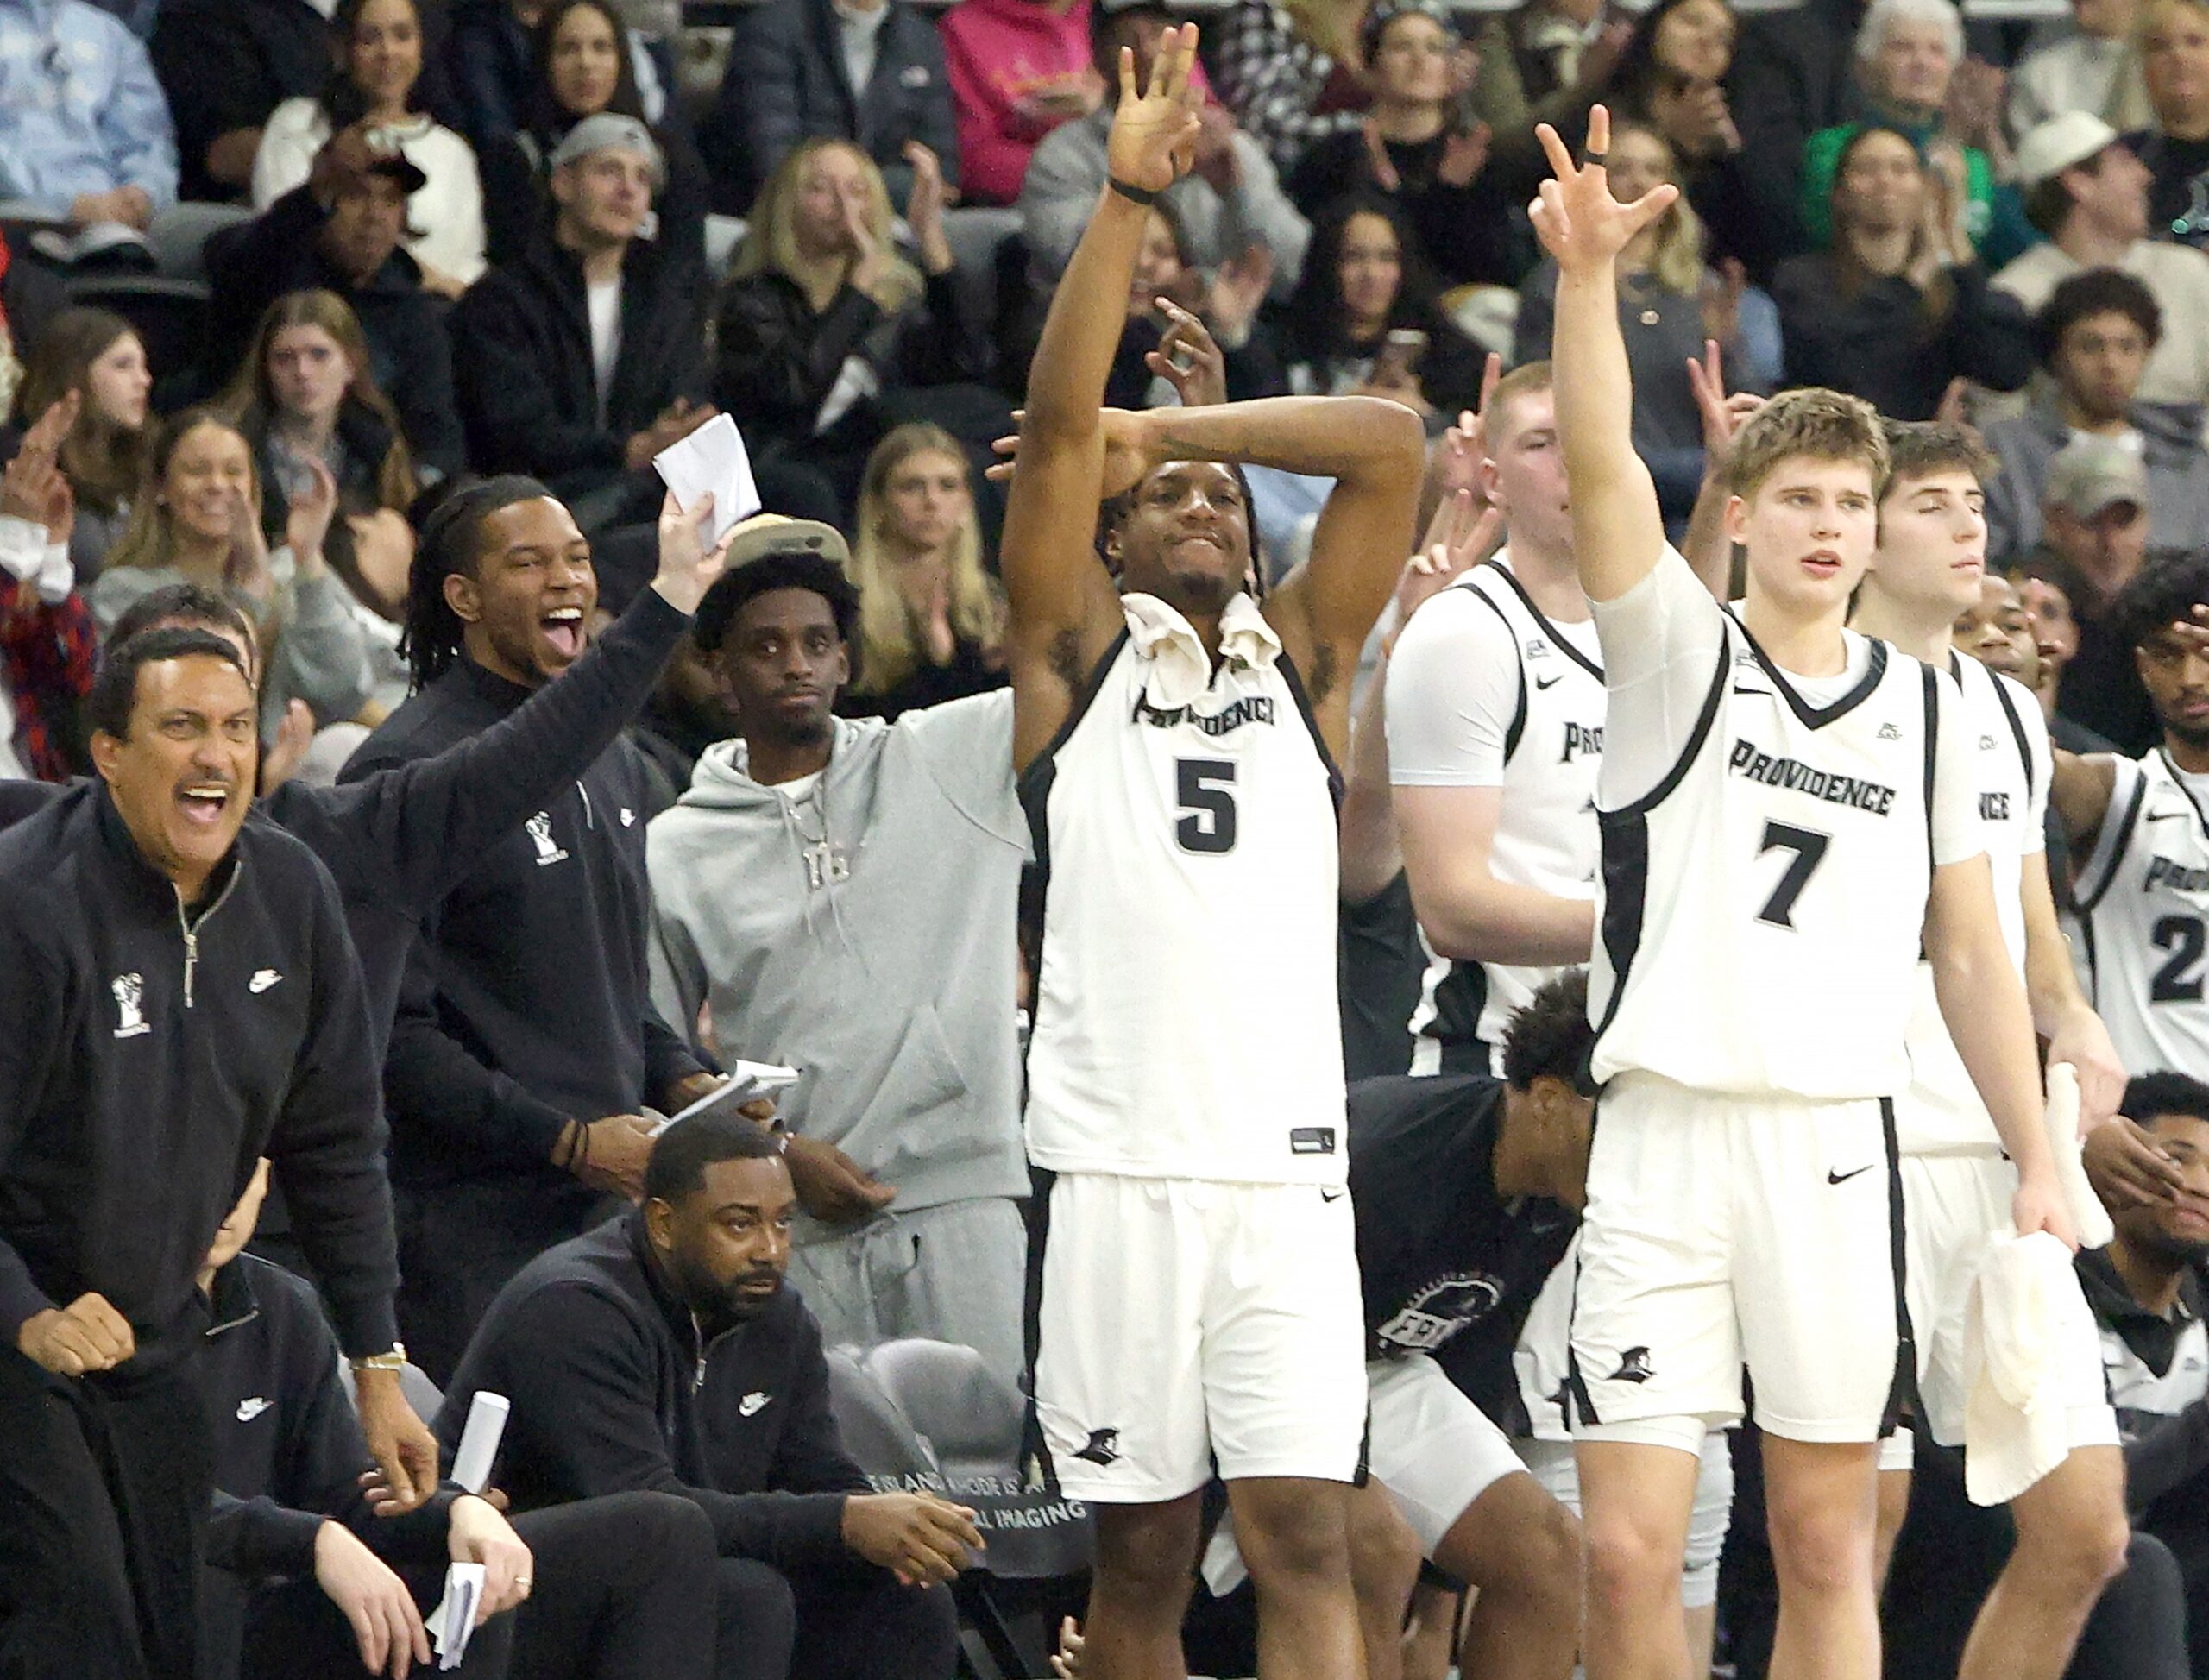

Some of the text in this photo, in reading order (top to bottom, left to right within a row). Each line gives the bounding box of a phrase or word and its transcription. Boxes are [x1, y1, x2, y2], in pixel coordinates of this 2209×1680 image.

[1174, 757, 1237, 855] 5
[1728, 737, 1897, 817] PROVIDENCE
[1754, 817, 1832, 932] 7
[2151, 915, 2206, 1002] 2
[994, 1500, 1087, 1531] IMAGING
